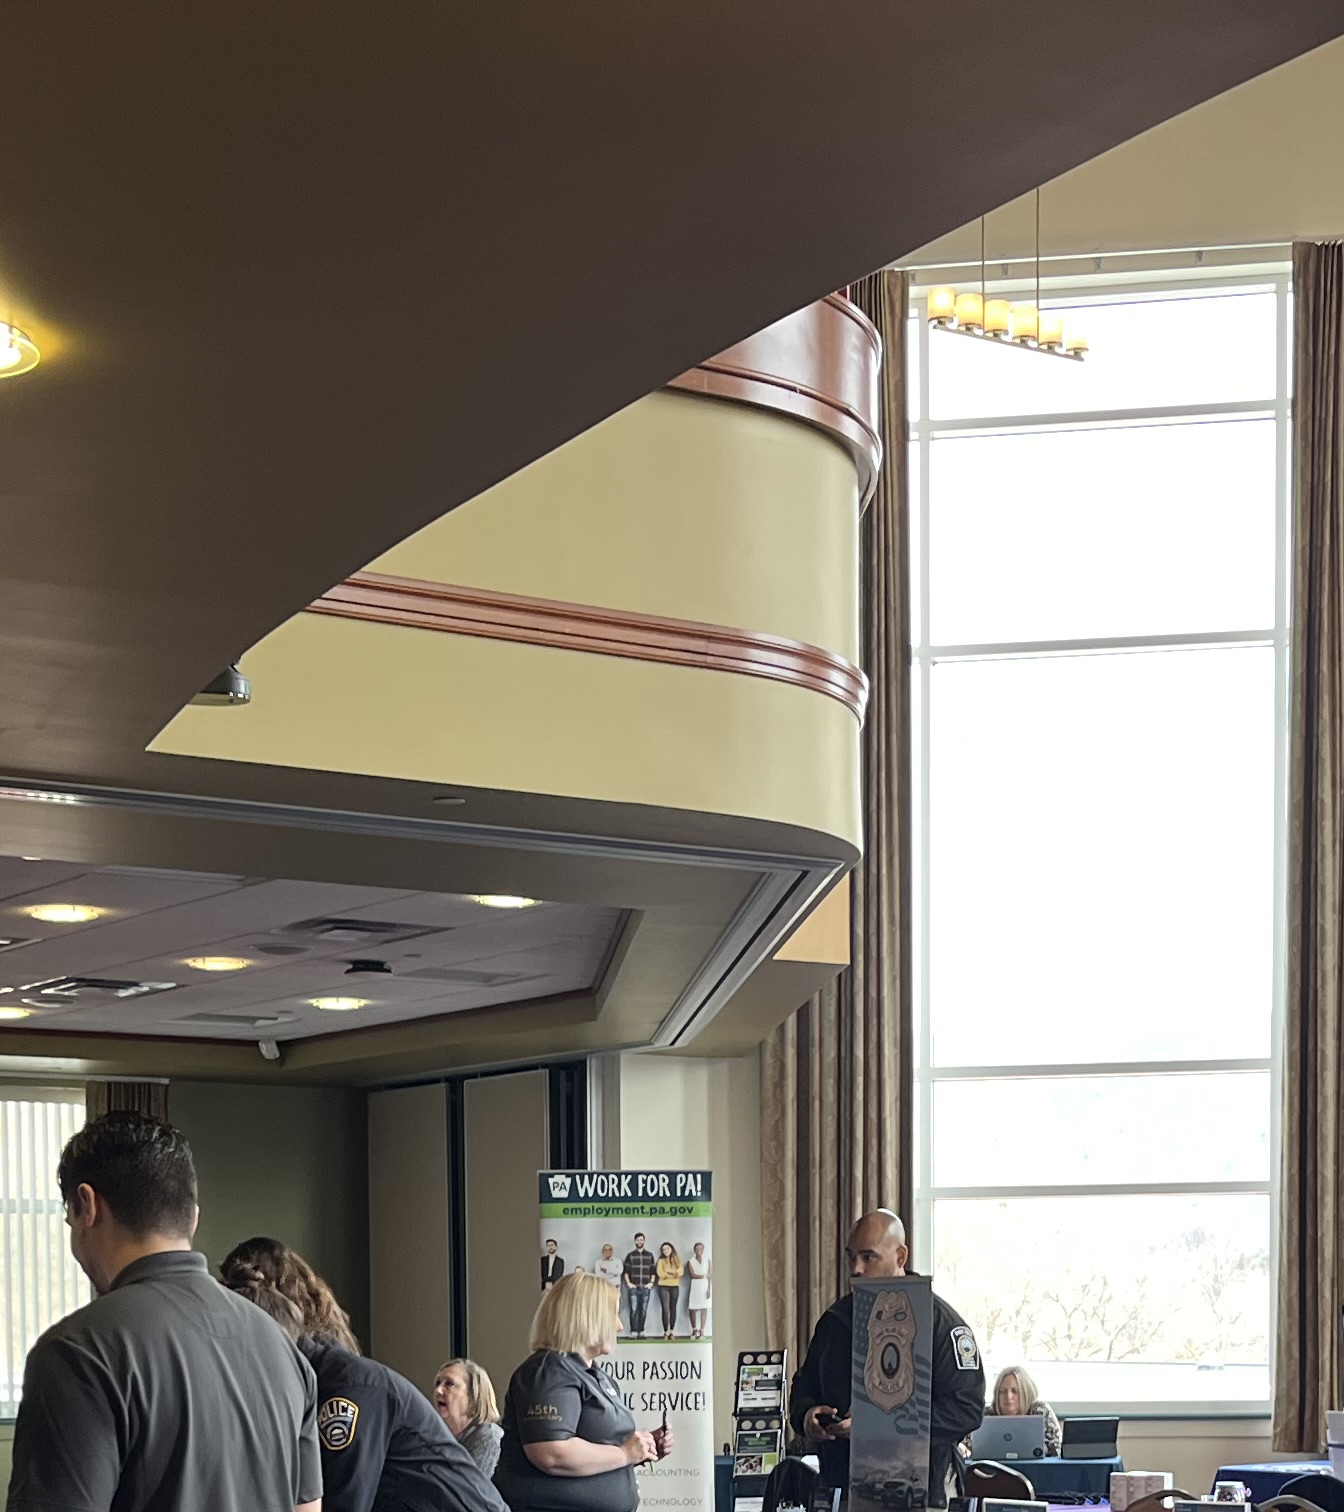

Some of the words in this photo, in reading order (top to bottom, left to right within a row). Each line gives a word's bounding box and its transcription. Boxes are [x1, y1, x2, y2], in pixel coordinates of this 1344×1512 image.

[575, 1173, 633, 1198] WORK
[637, 1173, 671, 1198] FOR
[676, 1173, 702, 1197] PA!
[562, 1205, 694, 1217] employment.pa.gov
[642, 1360, 702, 1380] PASSION
[623, 1392, 635, 1411] IC
[641, 1391, 706, 1412] SERVICE!
[527, 1404, 558, 1415] 45th
[636, 1468, 700, 1477] ACCOUNTING
[640, 1498, 703, 1506] ECHNOLOGY
